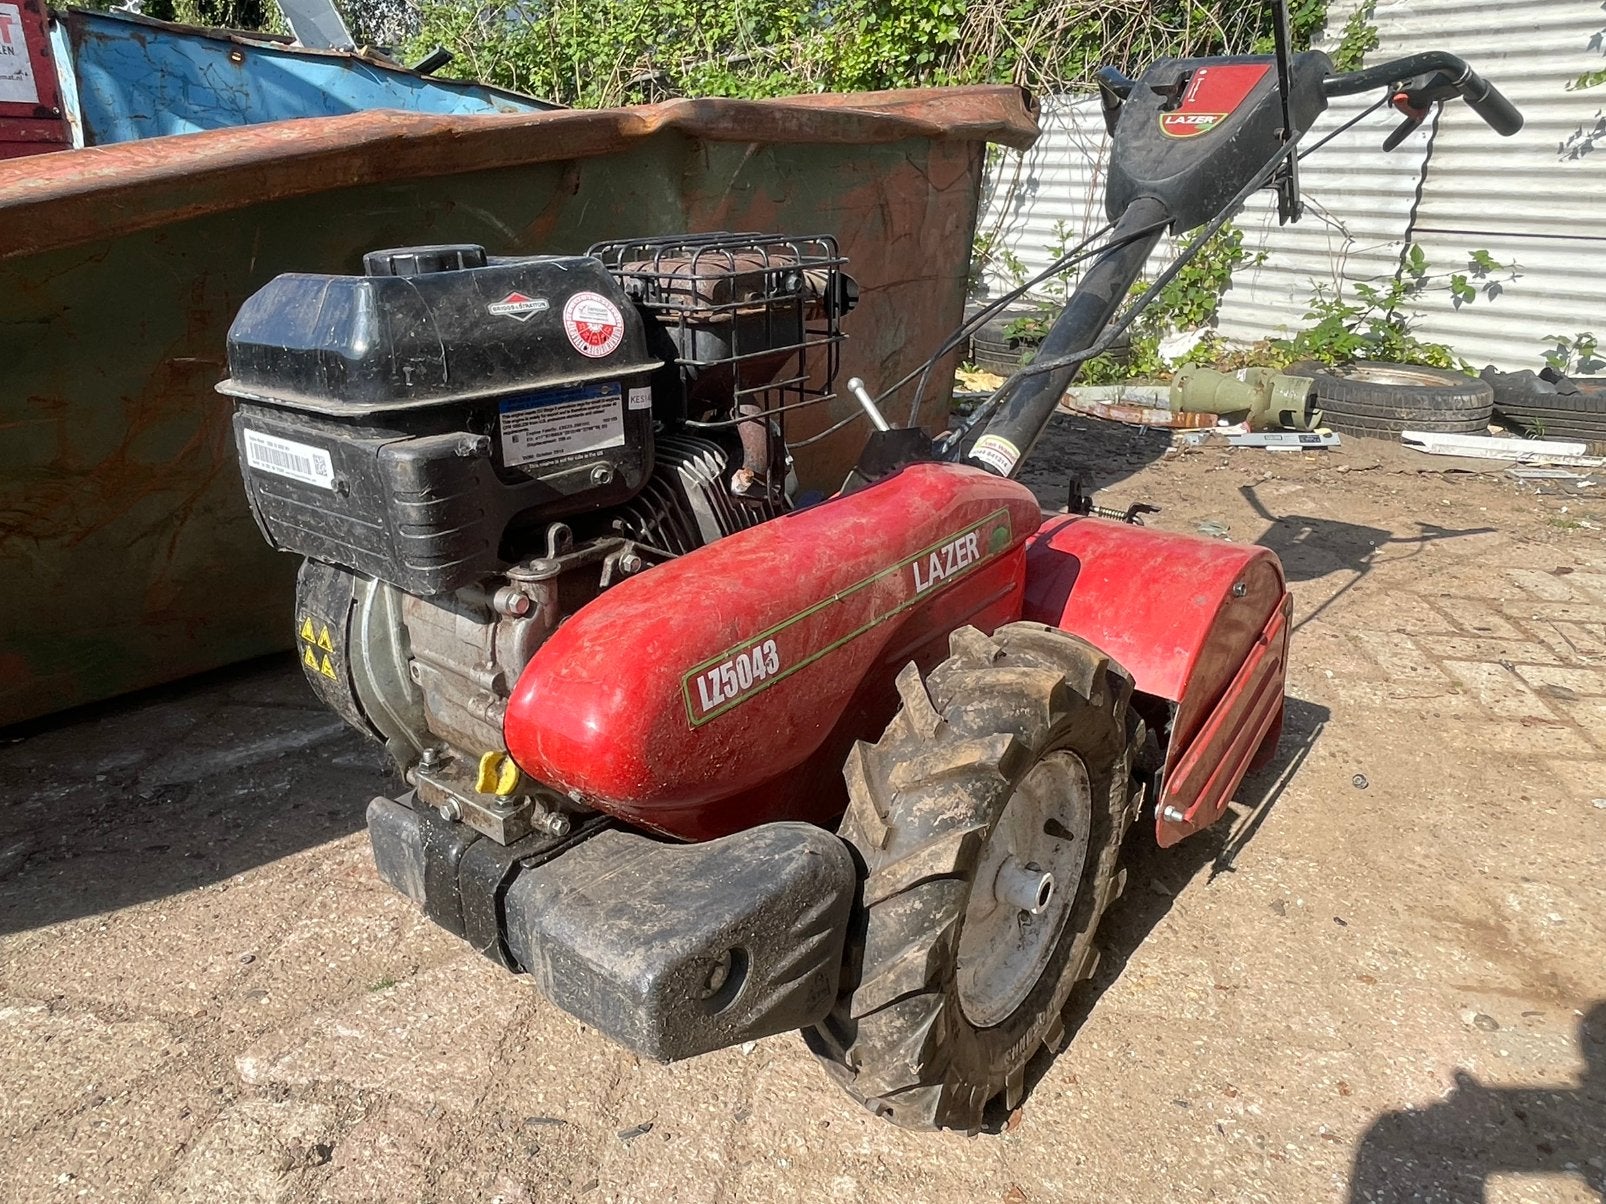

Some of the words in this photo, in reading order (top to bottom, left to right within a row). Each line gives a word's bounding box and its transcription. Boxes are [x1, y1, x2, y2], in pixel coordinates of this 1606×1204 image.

[1165, 115, 1215, 124] LAZER
[912, 532, 980, 593] LAZER
[696, 639, 780, 712] LZ5043
